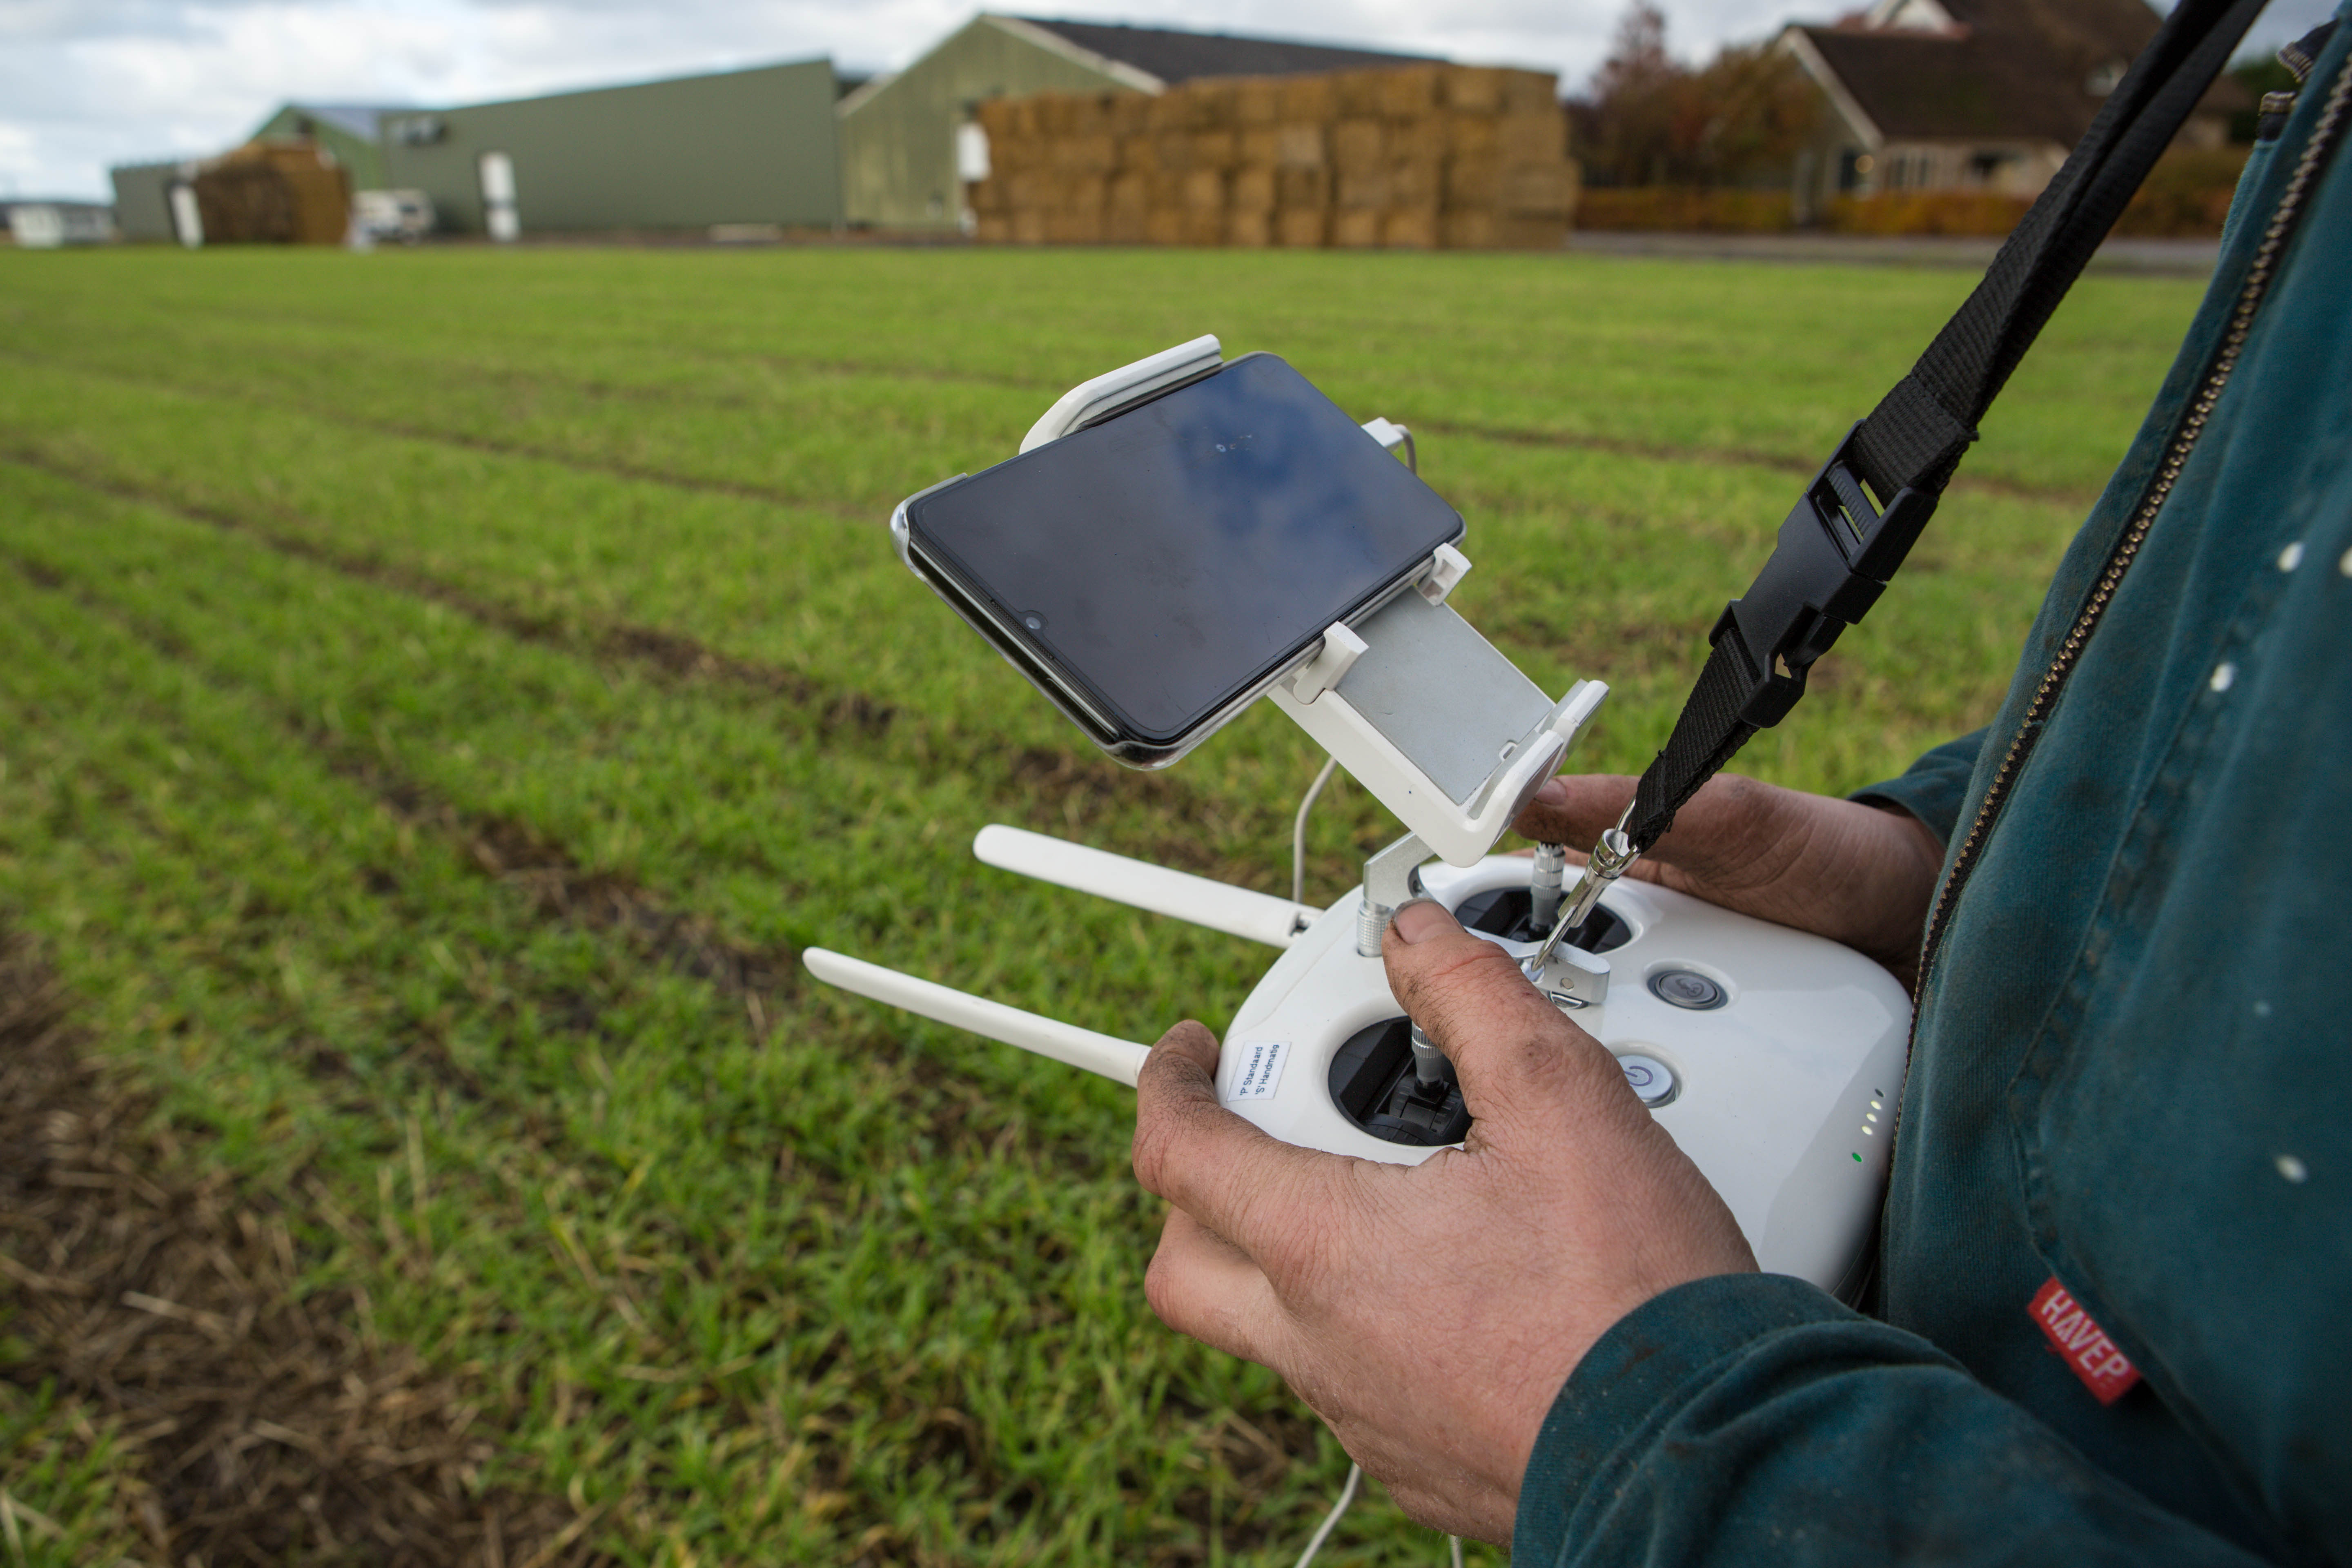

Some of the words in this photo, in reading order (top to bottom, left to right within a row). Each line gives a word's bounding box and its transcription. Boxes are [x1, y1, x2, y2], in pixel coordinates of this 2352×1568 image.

[1244, 1047, 1263, 1086] Standaard
[1259, 1045, 1279, 1084] Handmatig
[2041, 1289, 2130, 1379] HAVEP
